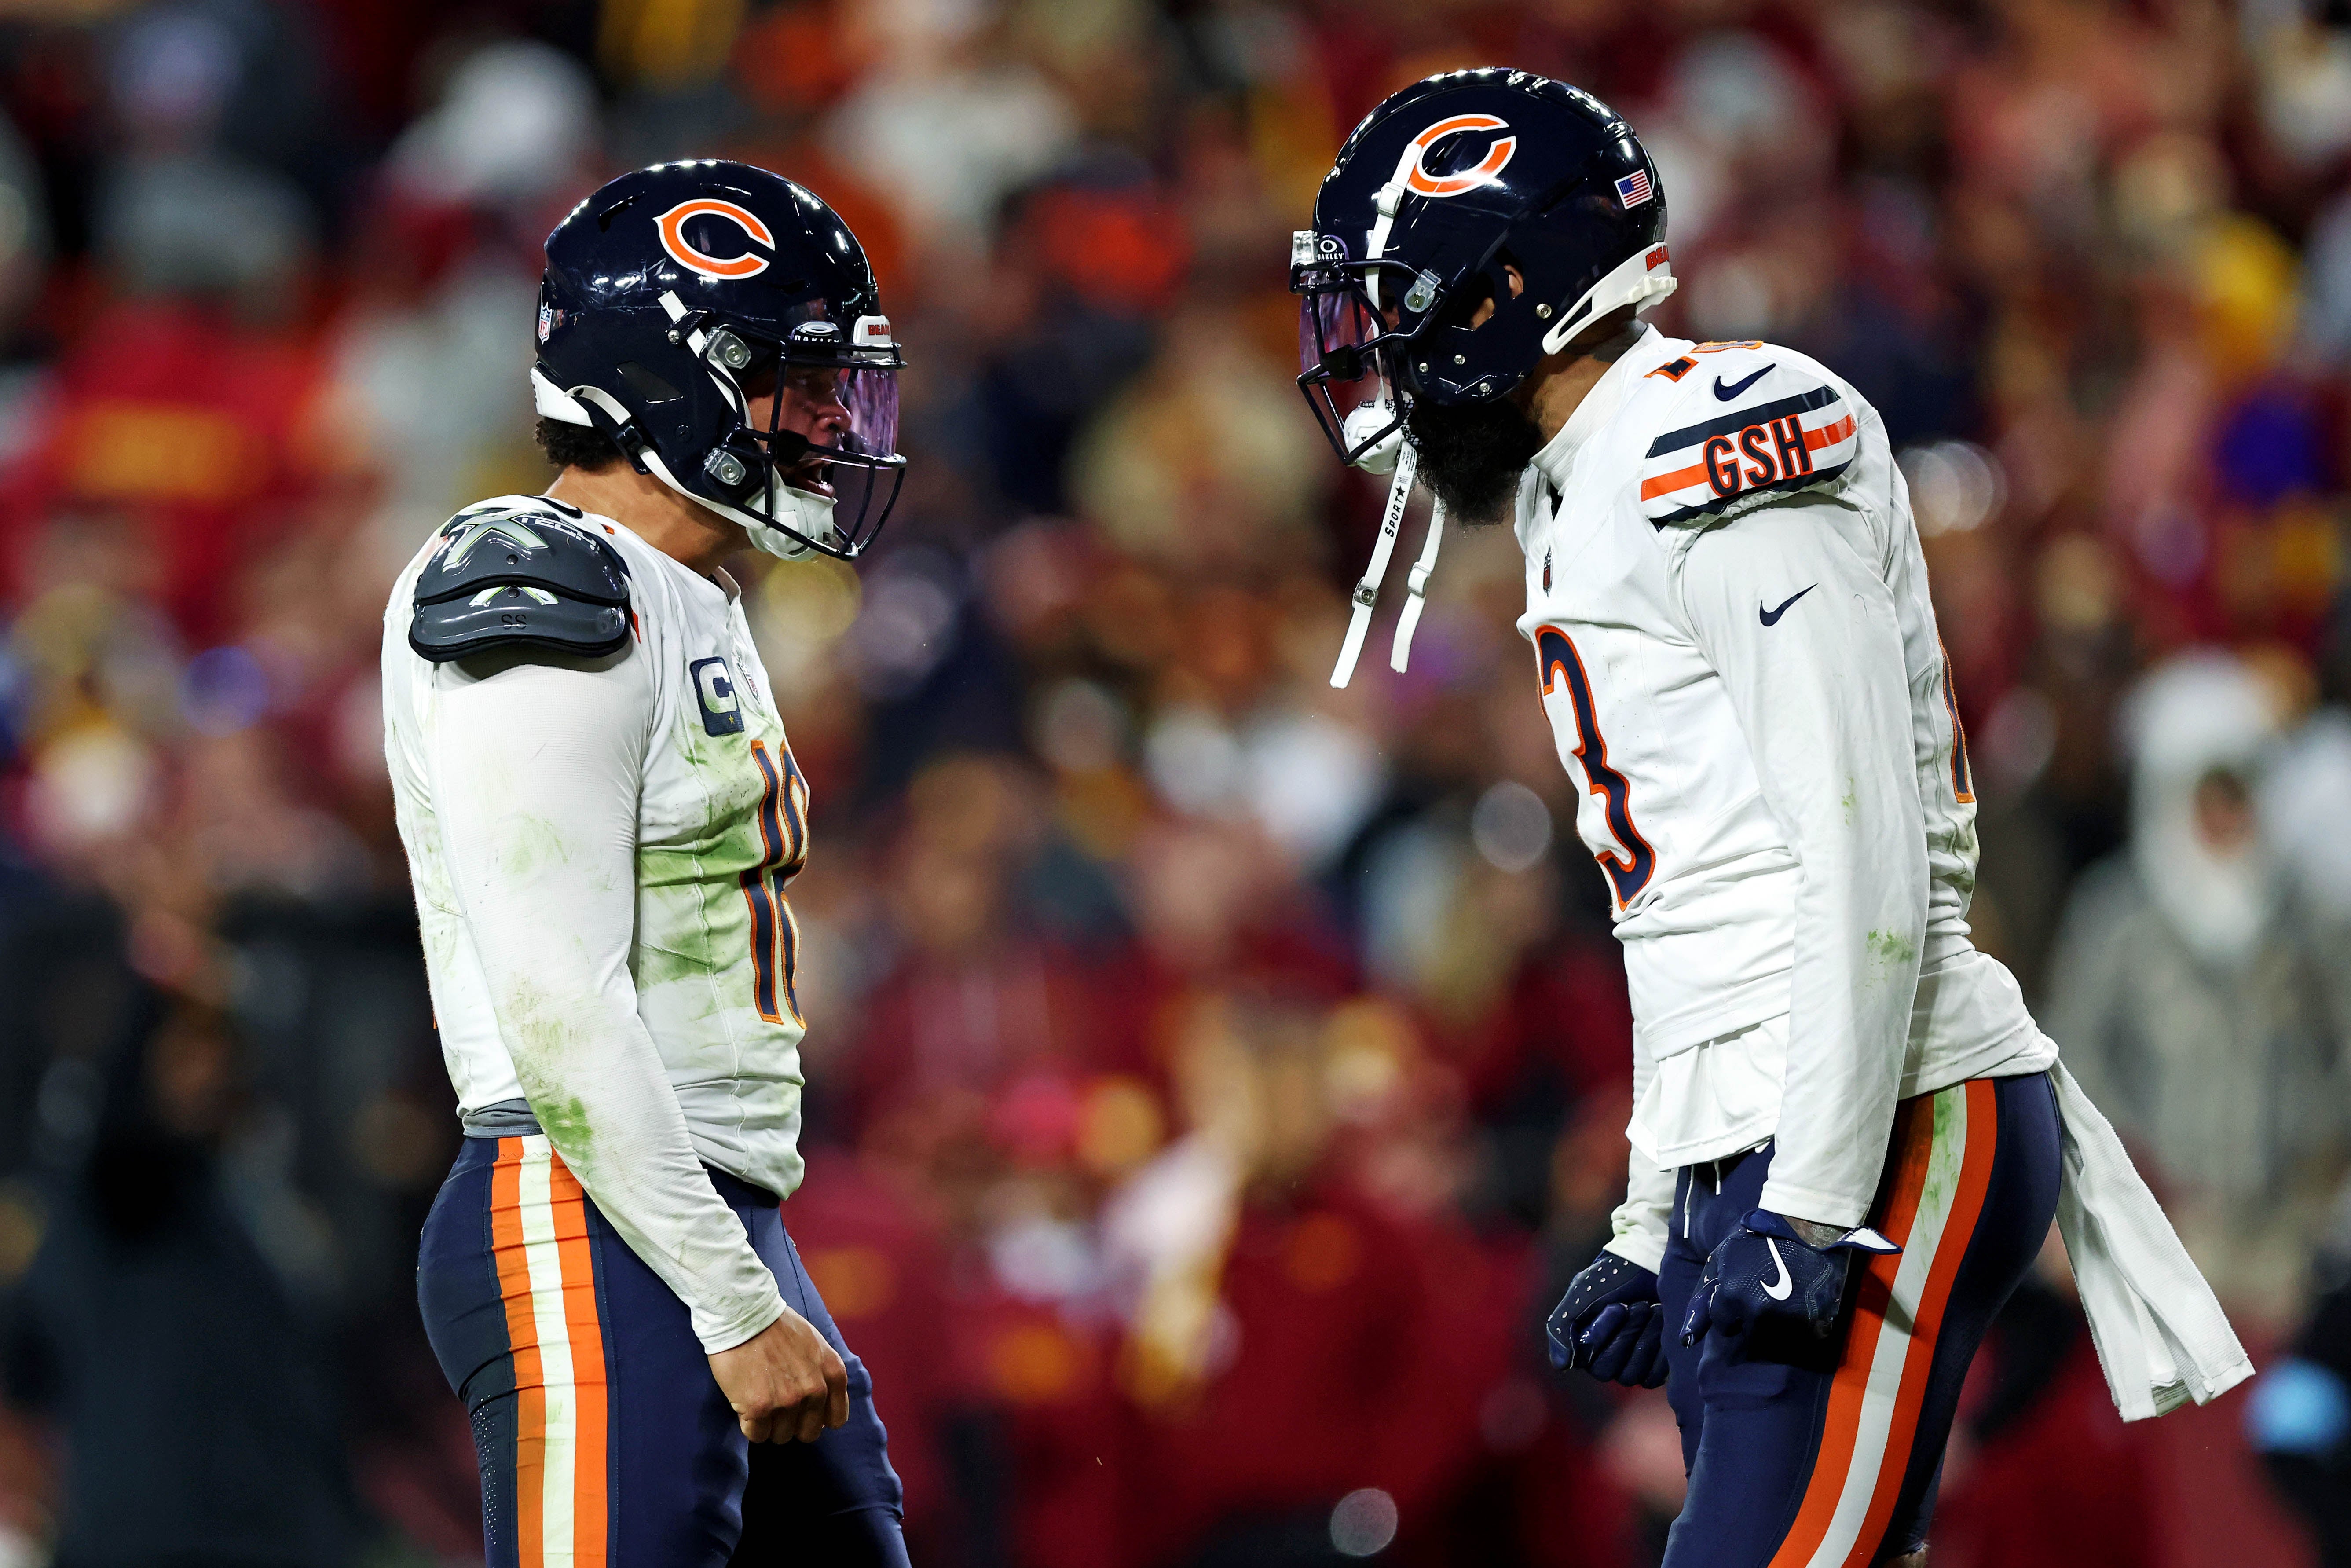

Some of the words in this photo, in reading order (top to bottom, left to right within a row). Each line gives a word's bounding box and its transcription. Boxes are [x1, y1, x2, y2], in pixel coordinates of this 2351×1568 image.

[1645, 245, 1670, 272] BEA
[1703, 413, 1813, 498] GSH
[501, 614, 527, 630] SS
[699, 662, 737, 714] C
